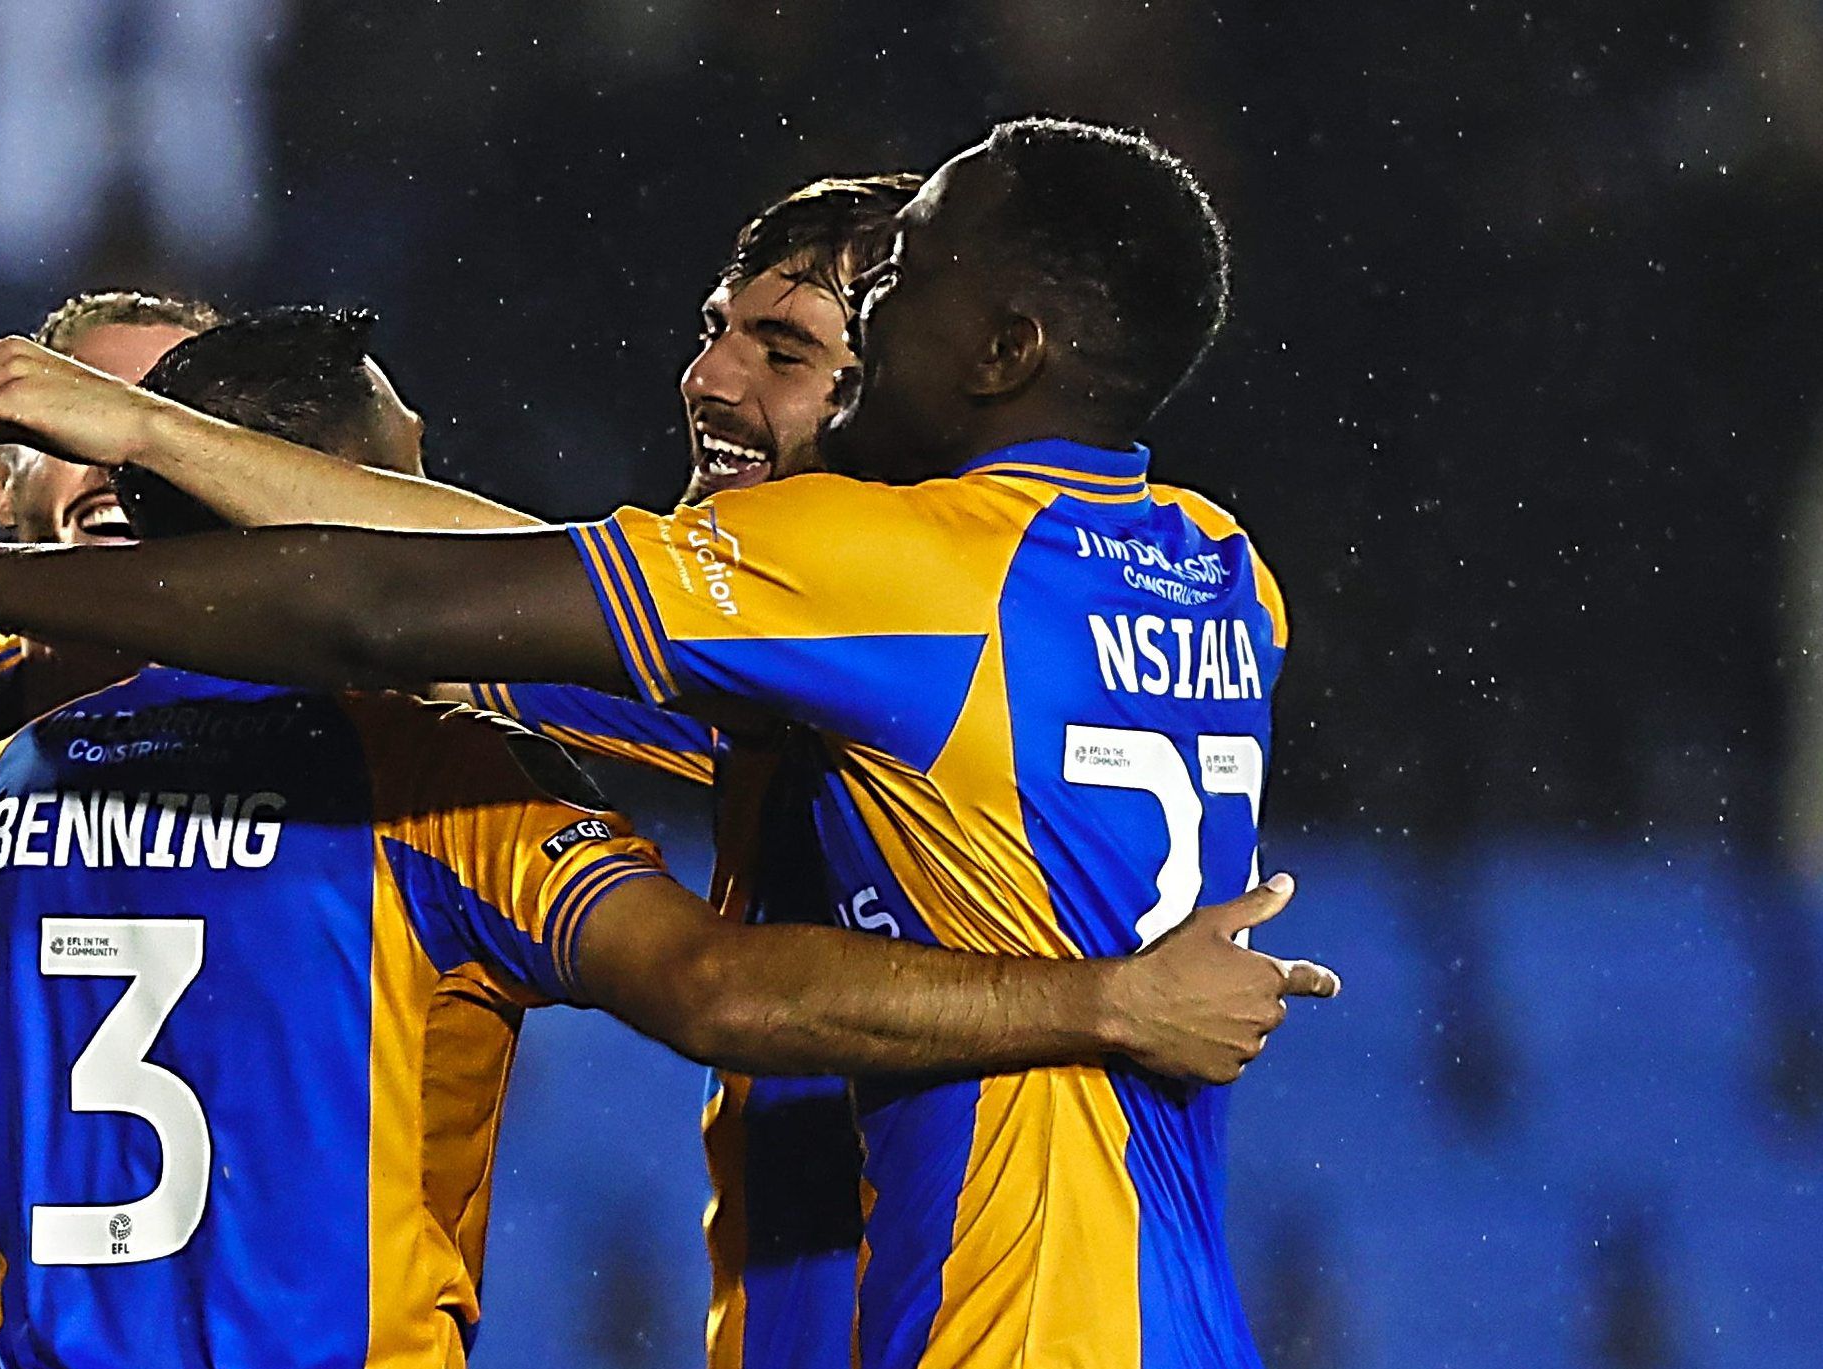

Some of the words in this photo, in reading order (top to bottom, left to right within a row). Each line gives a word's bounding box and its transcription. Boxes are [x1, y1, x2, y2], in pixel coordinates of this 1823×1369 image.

[1088, 614, 1263, 700] NSIALA
[66, 936, 82, 947] EFL
[83, 937, 94, 947] IN
[94, 937, 110, 947] THE
[66, 946, 119, 957] COMMUNITY
[30, 916, 211, 1265] 3
[111, 1242, 131, 1255] EFL
